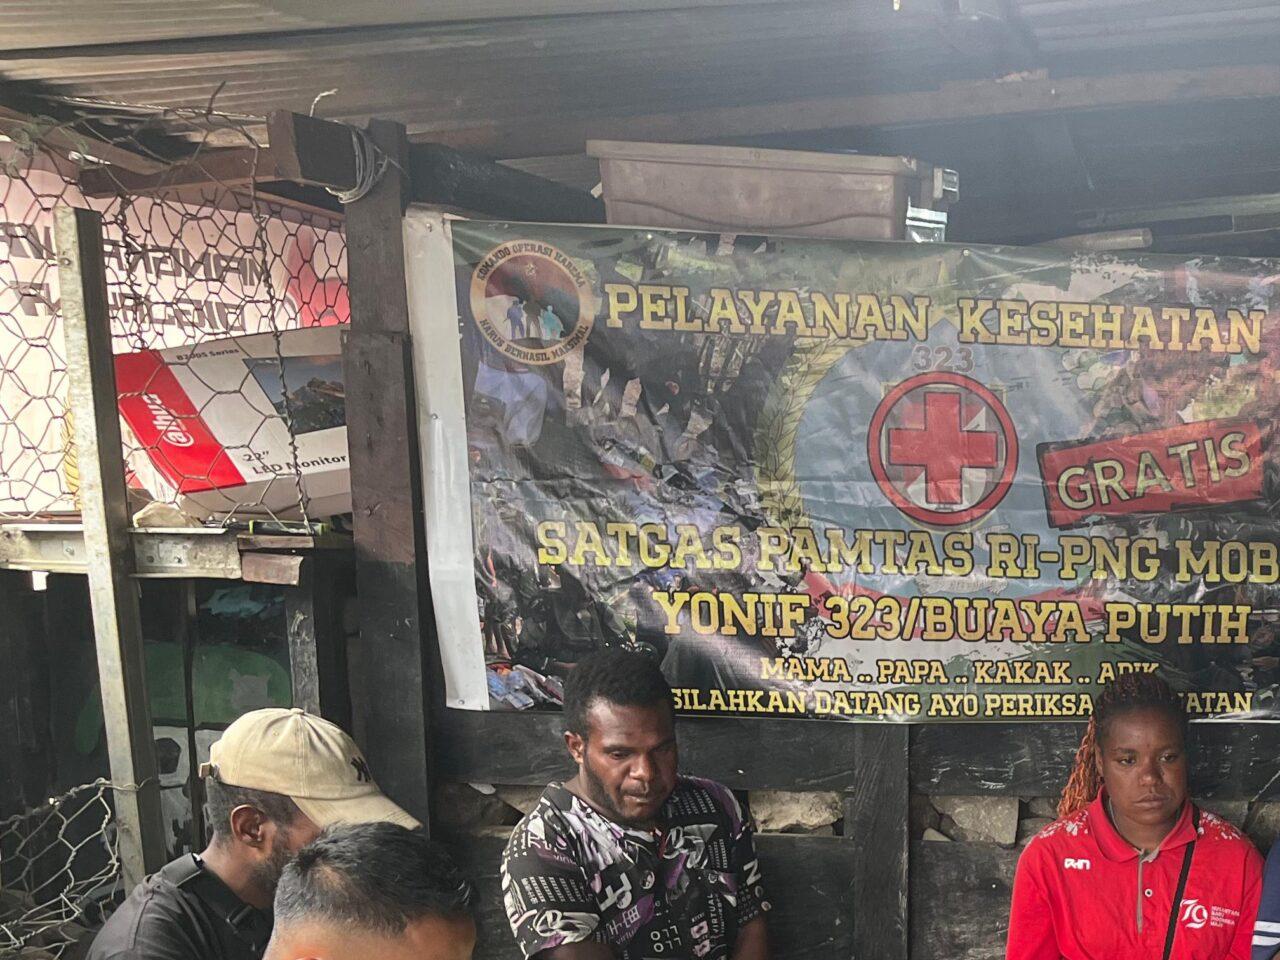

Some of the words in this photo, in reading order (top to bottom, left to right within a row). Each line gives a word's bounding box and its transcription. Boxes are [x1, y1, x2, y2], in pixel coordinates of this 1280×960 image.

[512, 244, 552, 257] OPERASI
[604, 282, 930, 342] PELAYANAN
[957, 298, 1267, 355] KESEHATAN
[912, 344, 974, 373] 323
[1056, 432, 1252, 512] GRATIS
[536, 521, 742, 571] SATGAS
[756, 528, 973, 578] PAMTAS
[987, 533, 1161, 581] RI-PNG
[653, 590, 811, 639] YONIF
[823, 595, 1092, 643] 323/BUAYA
[1104, 603, 1252, 645] PUTIH
[760, 656, 852, 682] MAMA
[877, 660, 948, 685] PAPA
[974, 661, 1072, 685] KAKAK
[815, 691, 921, 716] DATANG
[927, 693, 978, 717] AYO
[984, 692, 1094, 717] PERIKSA
